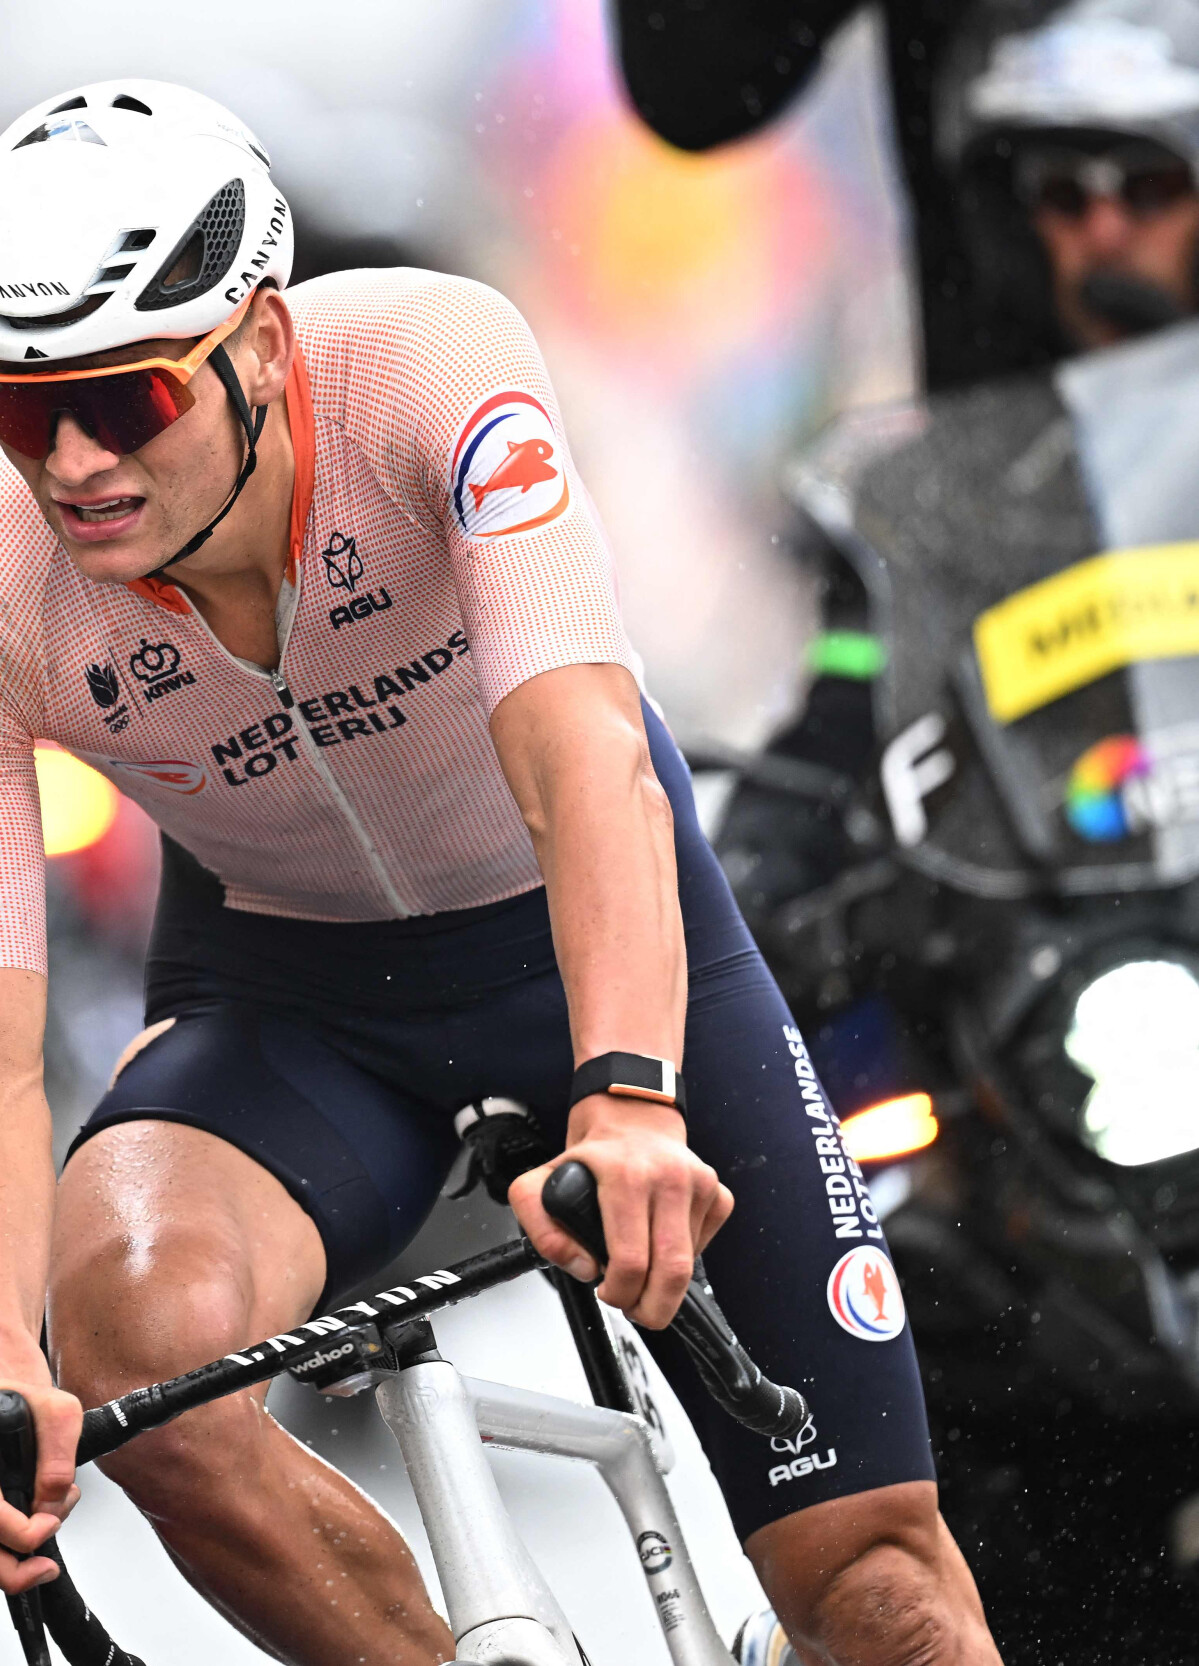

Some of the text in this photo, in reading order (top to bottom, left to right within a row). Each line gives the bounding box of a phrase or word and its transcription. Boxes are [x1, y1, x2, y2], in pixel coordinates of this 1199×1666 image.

[225, 198, 286, 304] CANYON
[329, 588, 393, 629] AGU
[222, 706, 406, 786] LOTERIJ
[782, 1024, 863, 1239] NEDERLANDSE
[225, 1269, 462, 1366] CANYON
[291, 1343, 355, 1375] wahoo
[768, 1448, 838, 1487] AGU
